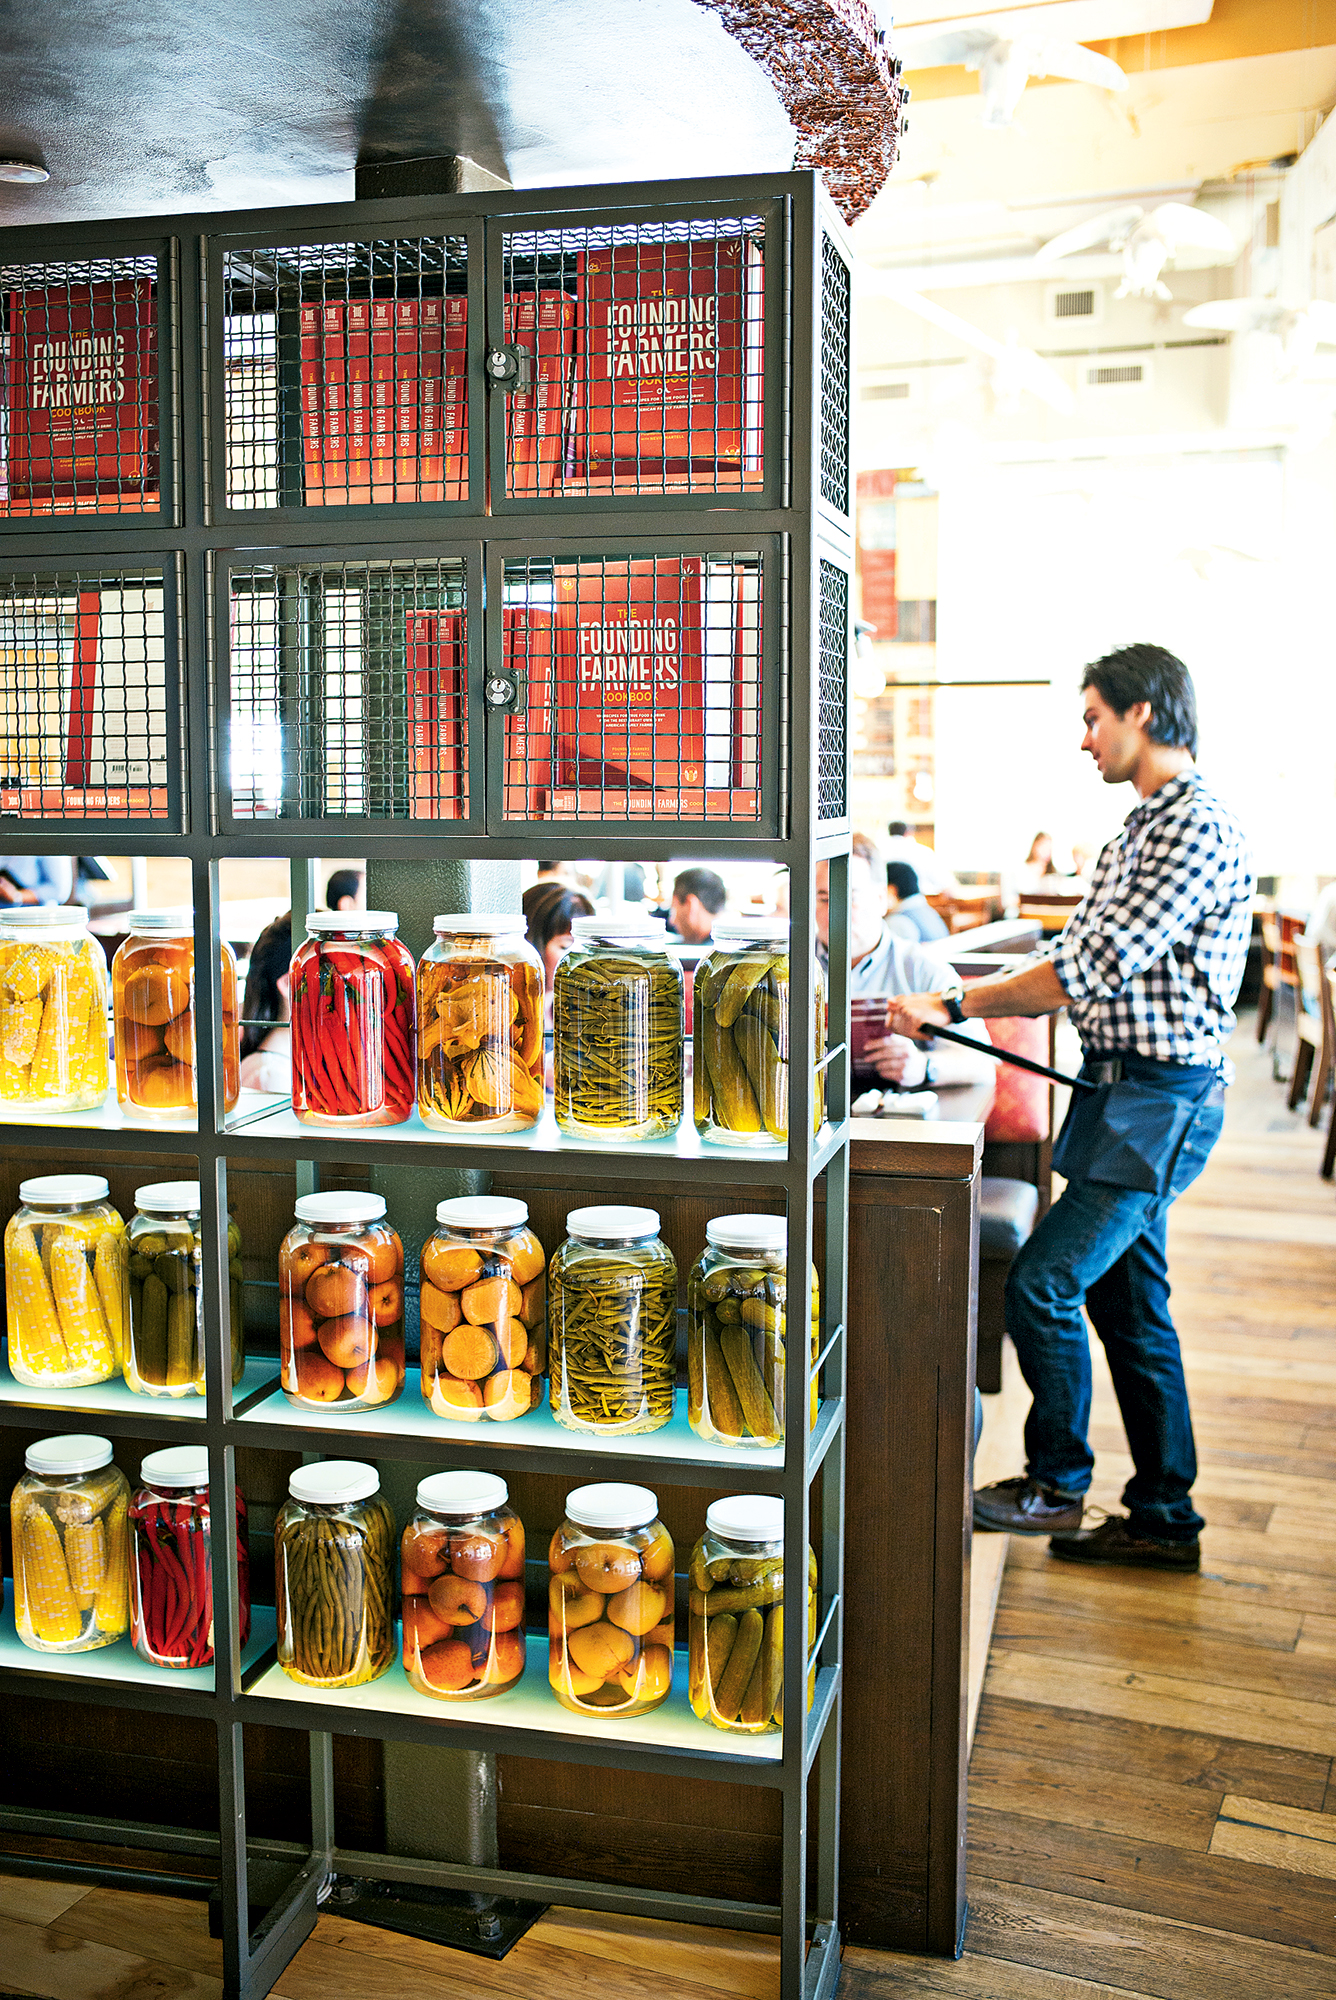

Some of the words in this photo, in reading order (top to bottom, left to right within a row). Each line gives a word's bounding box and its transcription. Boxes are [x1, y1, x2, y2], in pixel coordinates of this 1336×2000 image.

[607, 296, 718, 340] FOUNDING
[34, 334, 124, 374] FOUNDING
[606, 332, 719, 377] FARMERS
[33, 367, 125, 408] FARMERS
[447, 376, 456, 411] OUNDIG
[628, 372, 697, 387] COOKBOOK
[51, 405, 106, 418] COOKBOOK
[376, 380, 385, 414] OUNDIG
[309, 418, 319, 450] FARMERS
[330, 418, 339, 449] FARMERS
[354, 416, 363, 447] FARMERS
[515, 411, 525, 442] FARMES
[617, 608, 637, 618] THE
[580, 618, 676, 654] FOUNDING
[581, 655, 678, 691] FARMERS
[600, 691, 659, 702] COOKBOOK
[516, 723, 525, 754] FAMERS
[66, 796, 94, 806] FOUNDNG
[95, 796, 120, 806] FARERS
[624, 799, 655, 808] FUNDIN
